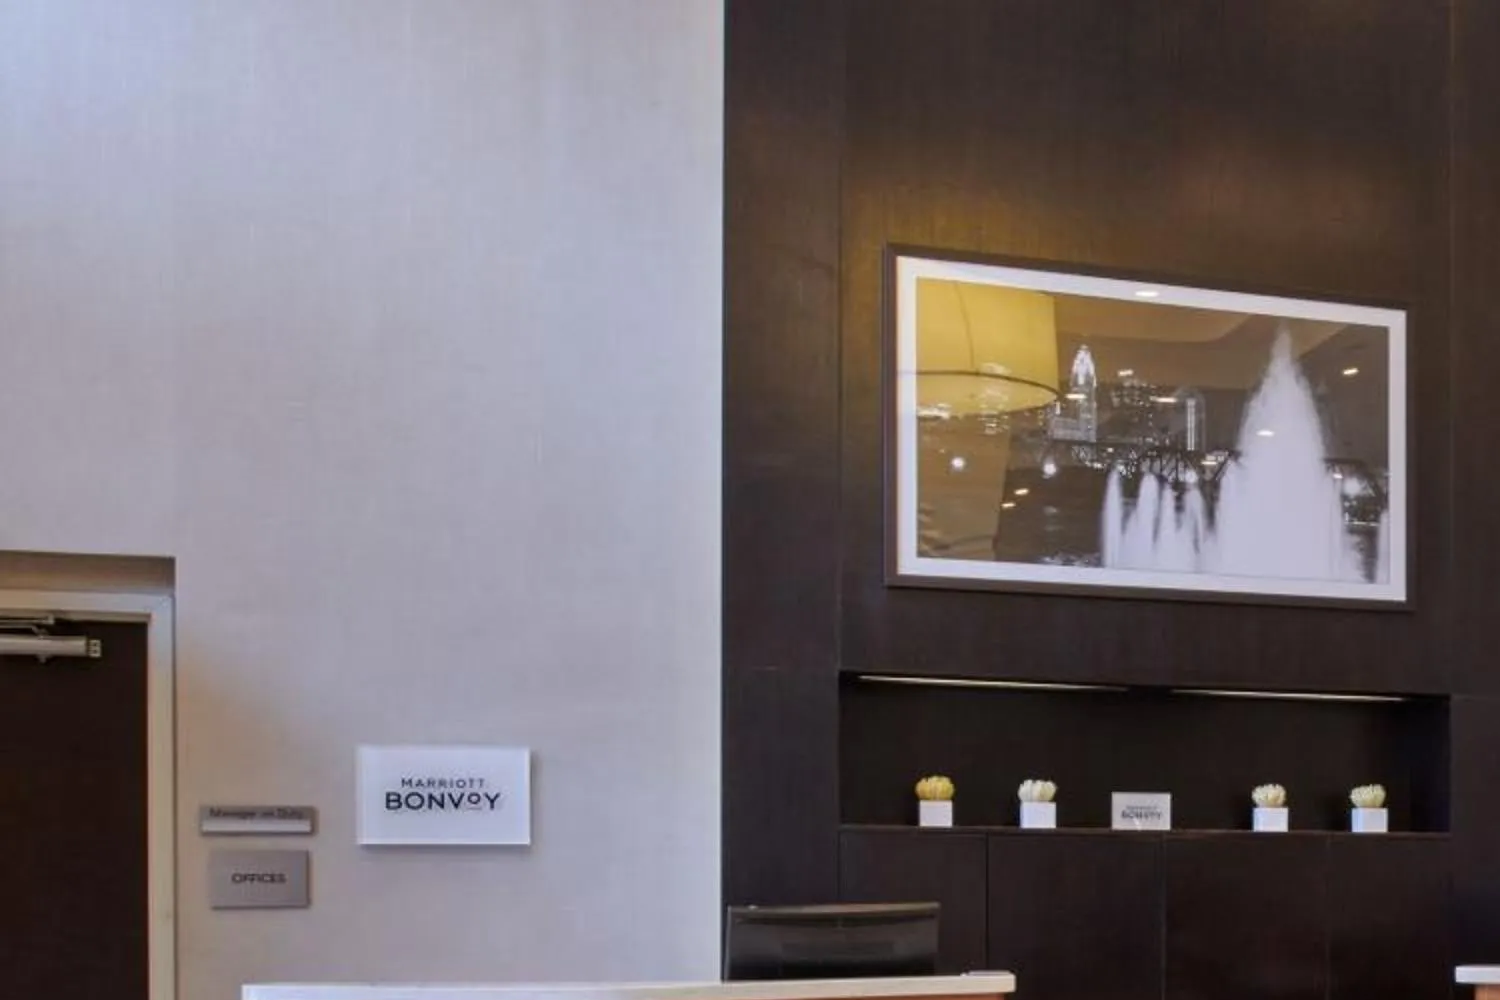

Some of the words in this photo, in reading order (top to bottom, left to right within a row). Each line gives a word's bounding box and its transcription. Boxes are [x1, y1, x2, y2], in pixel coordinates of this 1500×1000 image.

[401, 778, 485, 789] MARRIOTT
[385, 791, 501, 811] BONVOY
[231, 873, 287, 884] OFFICES
